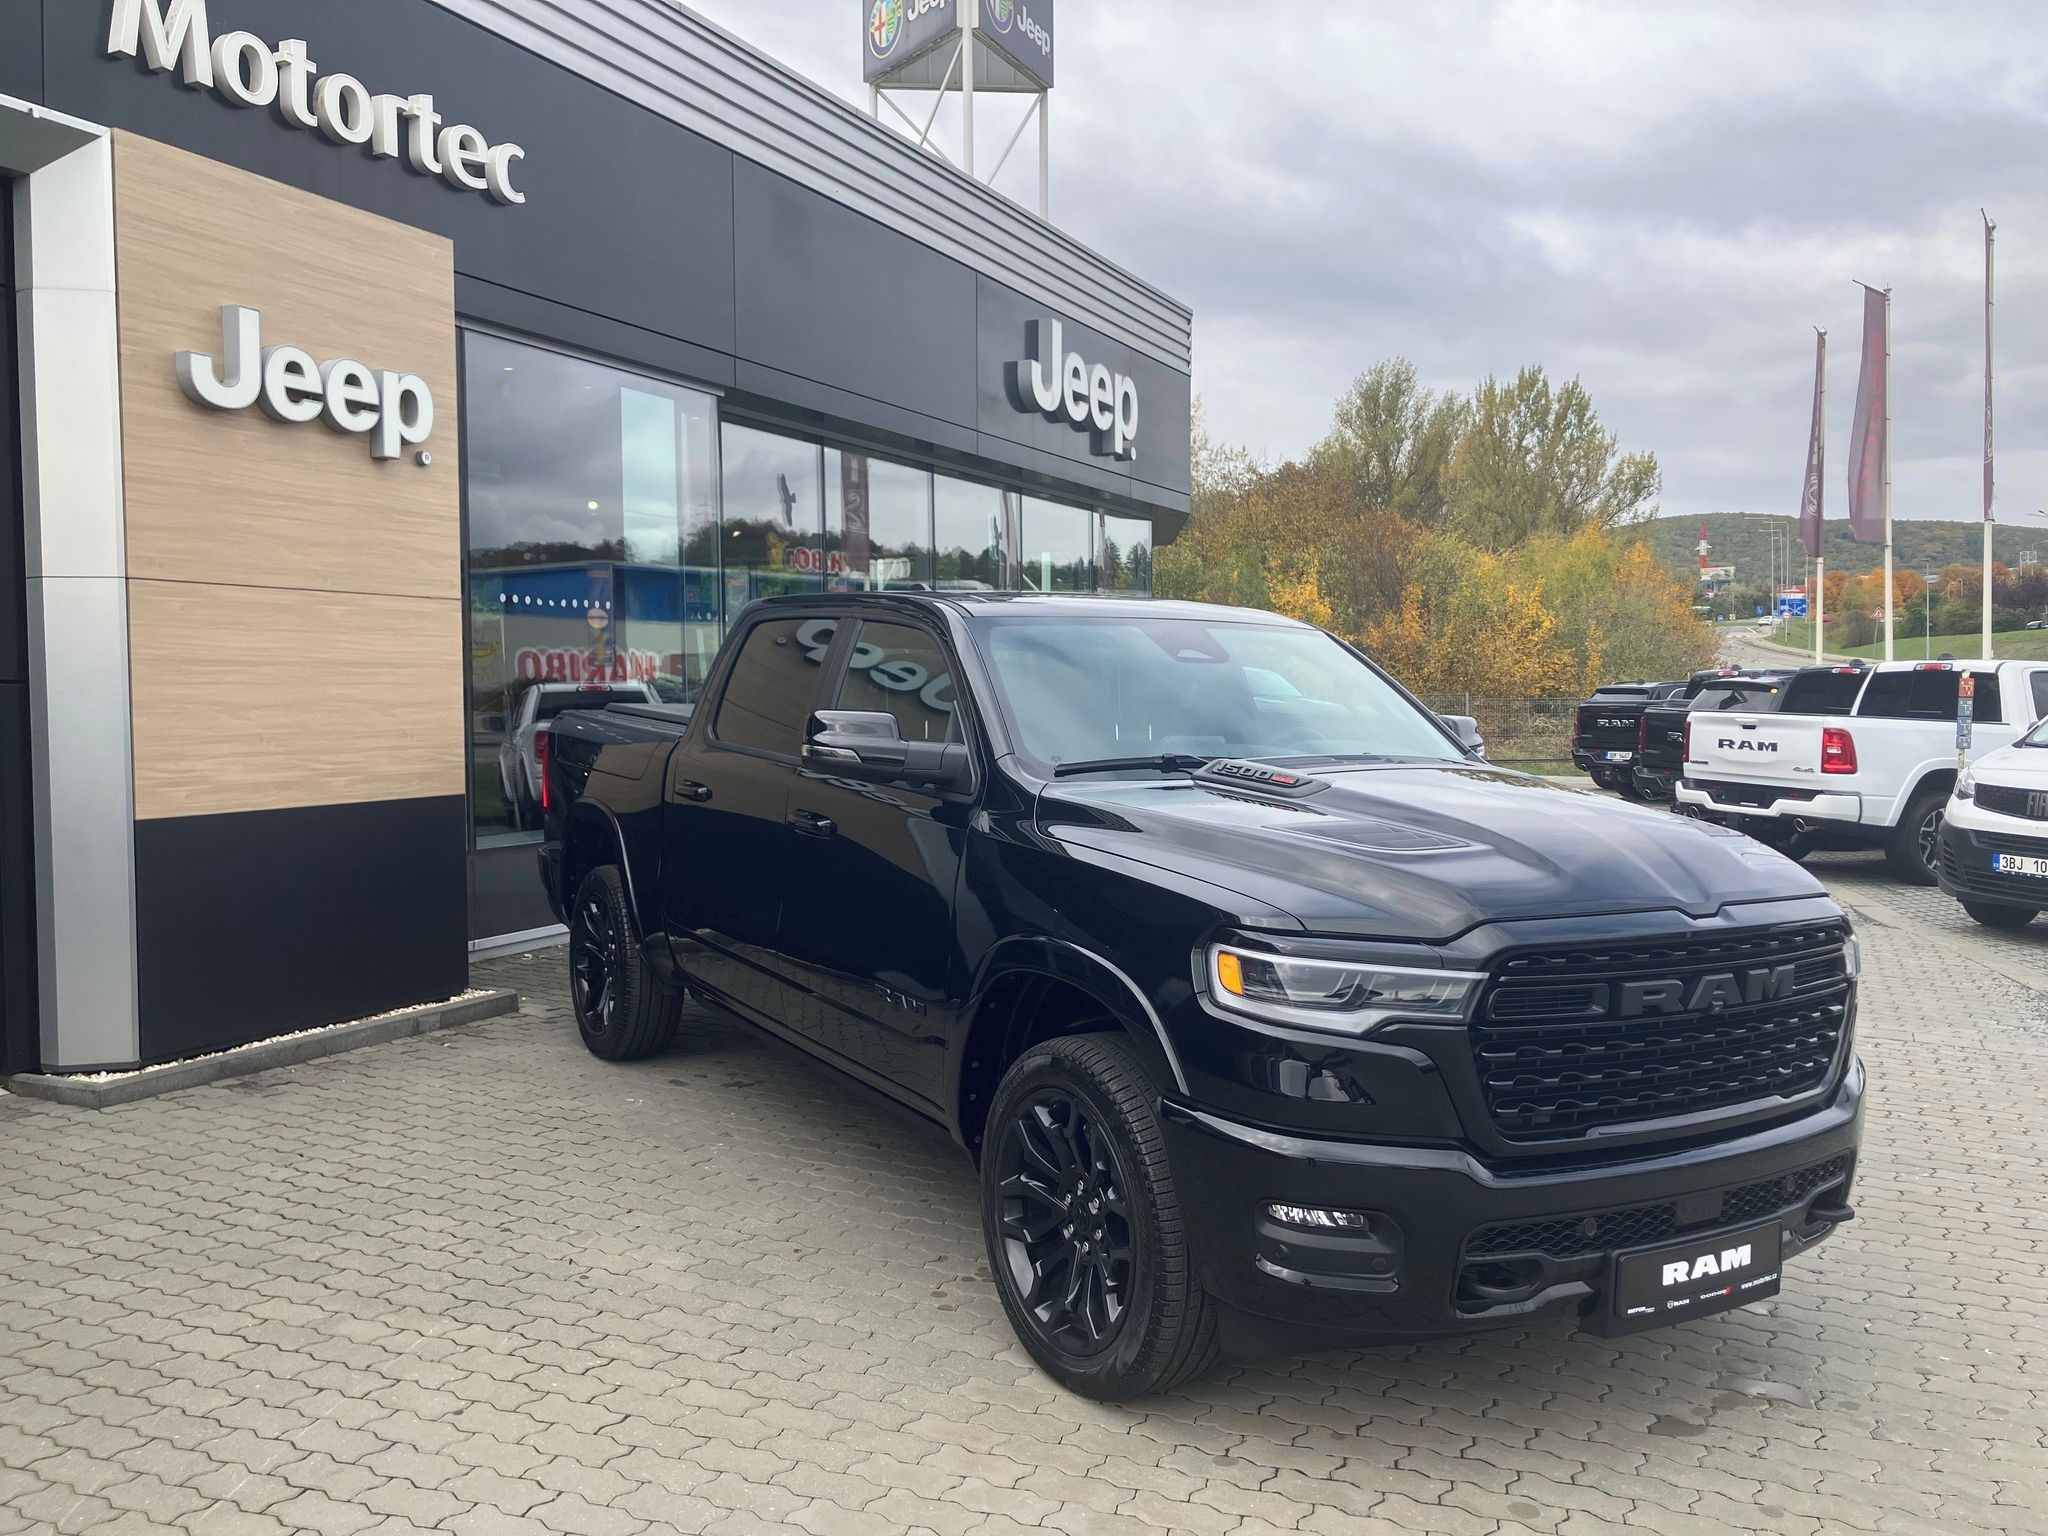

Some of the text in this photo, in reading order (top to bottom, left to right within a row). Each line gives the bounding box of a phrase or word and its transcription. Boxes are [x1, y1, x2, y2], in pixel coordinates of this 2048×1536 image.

[1016, 5, 1051, 56] Jeep
[107, 0, 526, 204] Motortec
[174, 303, 434, 461] Jeep
[1016, 317, 1138, 456] Jeep
[1597, 719, 1635, 728] RAM
[1718, 738, 1778, 752] RAM
[1211, 761, 1276, 780] 1500
[2002, 856, 2023, 871] 3BJ
[2033, 860, 2048, 873] 10
[1620, 963, 1795, 1017] RAM
[1662, 1243, 1752, 1287] RAM
